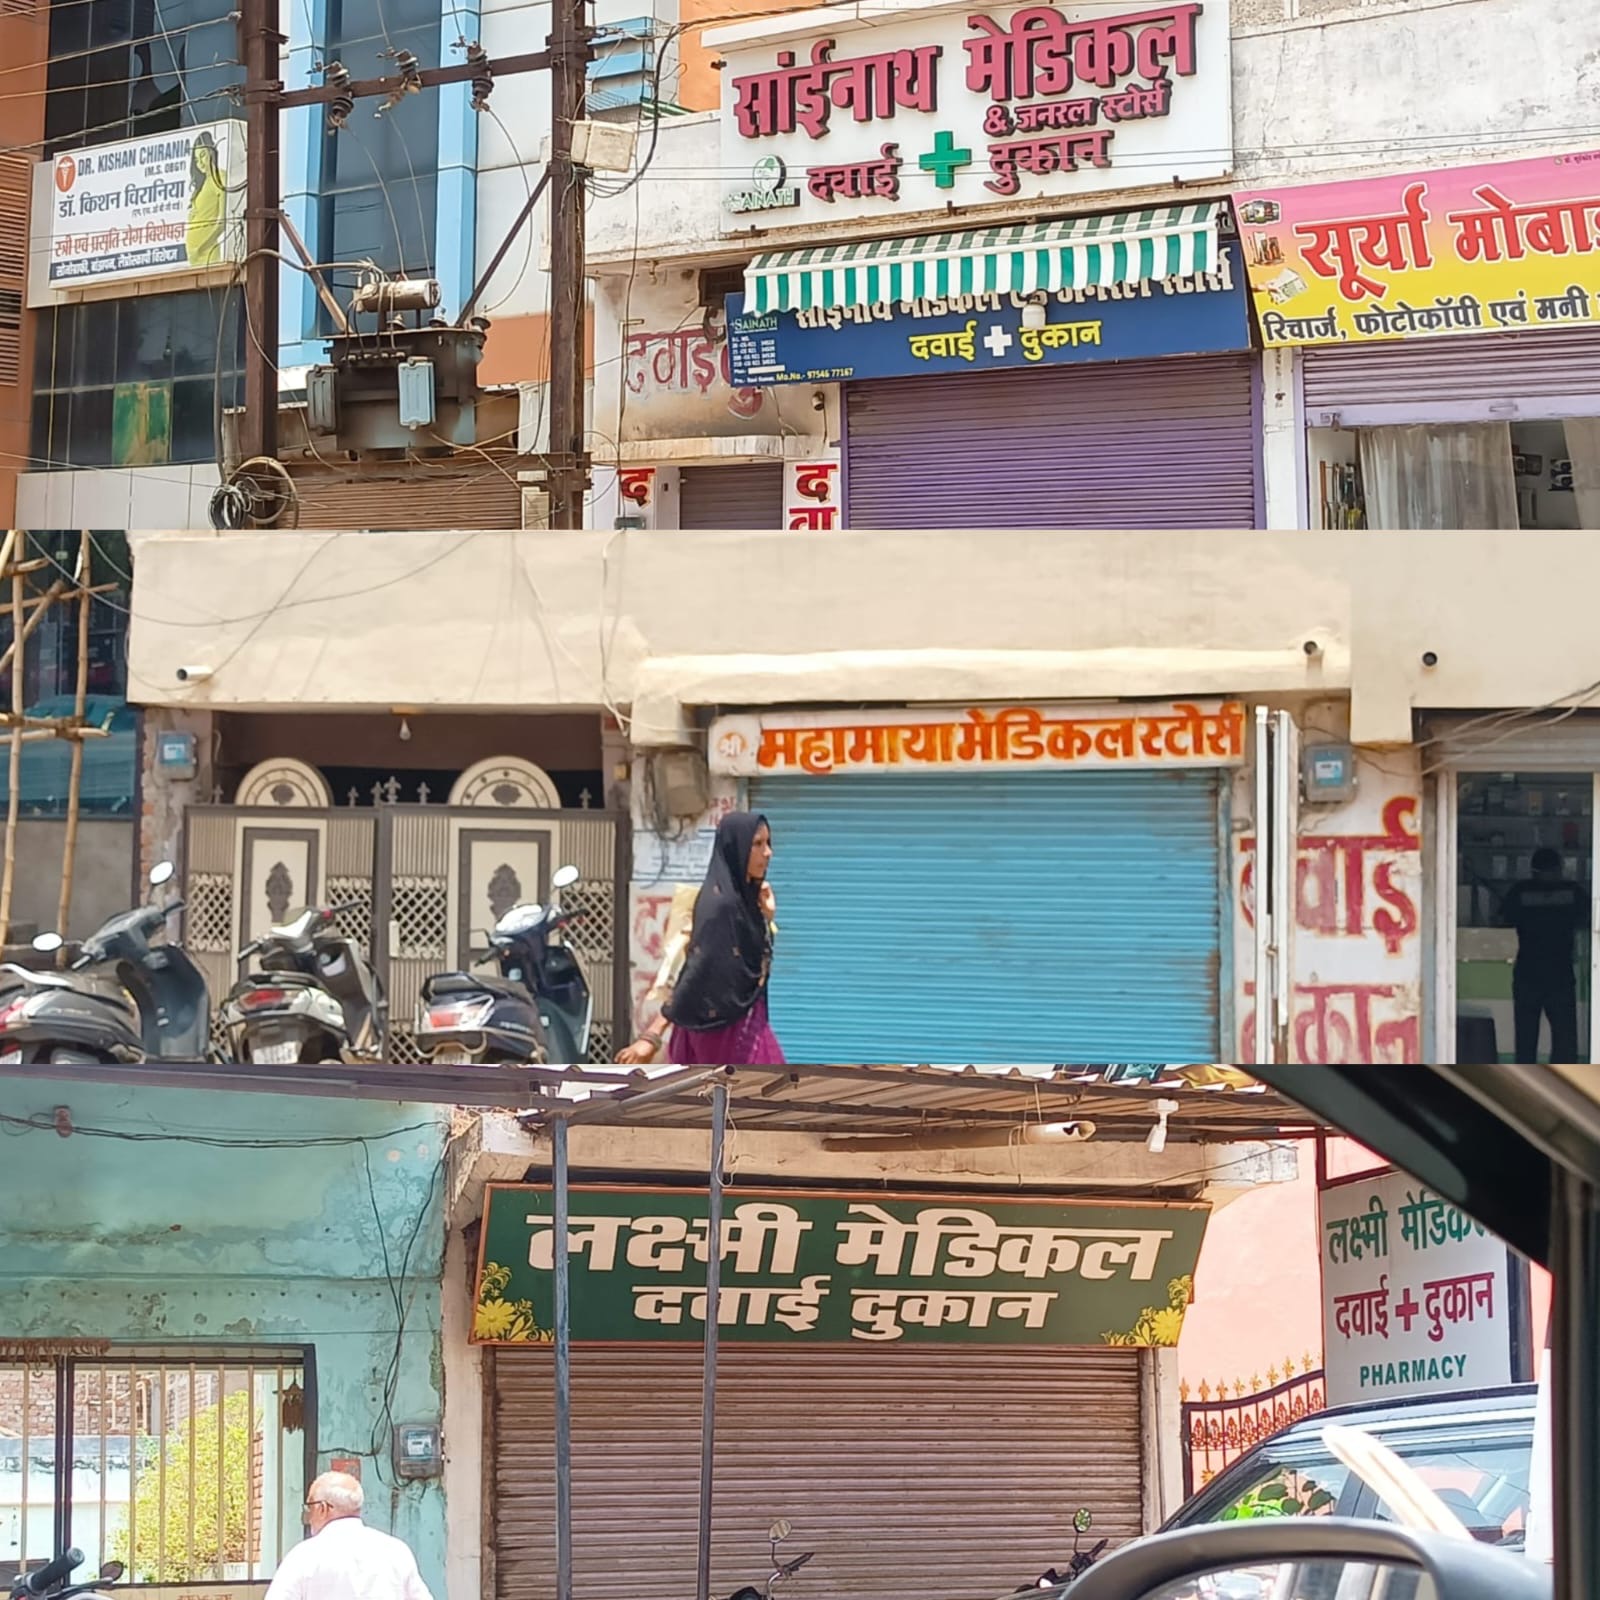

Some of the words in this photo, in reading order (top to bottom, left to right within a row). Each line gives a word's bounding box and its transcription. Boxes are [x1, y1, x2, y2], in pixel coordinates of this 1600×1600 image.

[732, 39, 943, 139] सांईनाथ
[962, 2, 1203, 102] मेडिकल
[983, 105, 1014, 137] &
[1013, 98, 1100, 134] जनरल
[1100, 79, 1172, 122] स्टोर्स
[77, 157, 95, 177] DR.
[97, 149, 136, 173] KISHAN
[139, 138, 192, 164] CHIRANIA
[806, 142, 902, 202] दवाई
[983, 130, 1114, 195] दुकान
[58, 193, 76, 218] डॉ.
[79, 190, 121, 215] किशन
[124, 178, 186, 207] चिरानिया
[724, 187, 800, 213] SAINATH
[55, 234, 72, 257] स्त्री
[74, 233, 89, 254] एवं
[91, 226, 120, 256] प्रसूति
[121, 223, 142, 247] रोग
[1295, 183, 1433, 300] सूर्या
[733, 317, 778, 331] SAINATH
[909, 320, 977, 361] दवाई
[1018, 319, 1102, 361] दुकान
[1263, 305, 1347, 341] रिचार्ज,
[1353, 296, 1481, 333] फोटोकॉपी
[1488, 290, 1527, 327] एवं
[1535, 285, 1590, 319] मनी
[757, 721, 955, 774] महामाया
[955, 706, 1136, 762] मेडिकल
[525, 1202, 813, 1274] लक्ष्मी
[835, 1203, 1174, 1281] मेडिकल
[1326, 1195, 1389, 1265] लक्ष्मी
[631, 1275, 832, 1333] दवाई
[850, 1288, 1059, 1341] दुकान
[1333, 1273, 1390, 1339] दवाई
[1423, 1271, 1495, 1343] दुकान
[1359, 1354, 1467, 1388] PHARMACY
